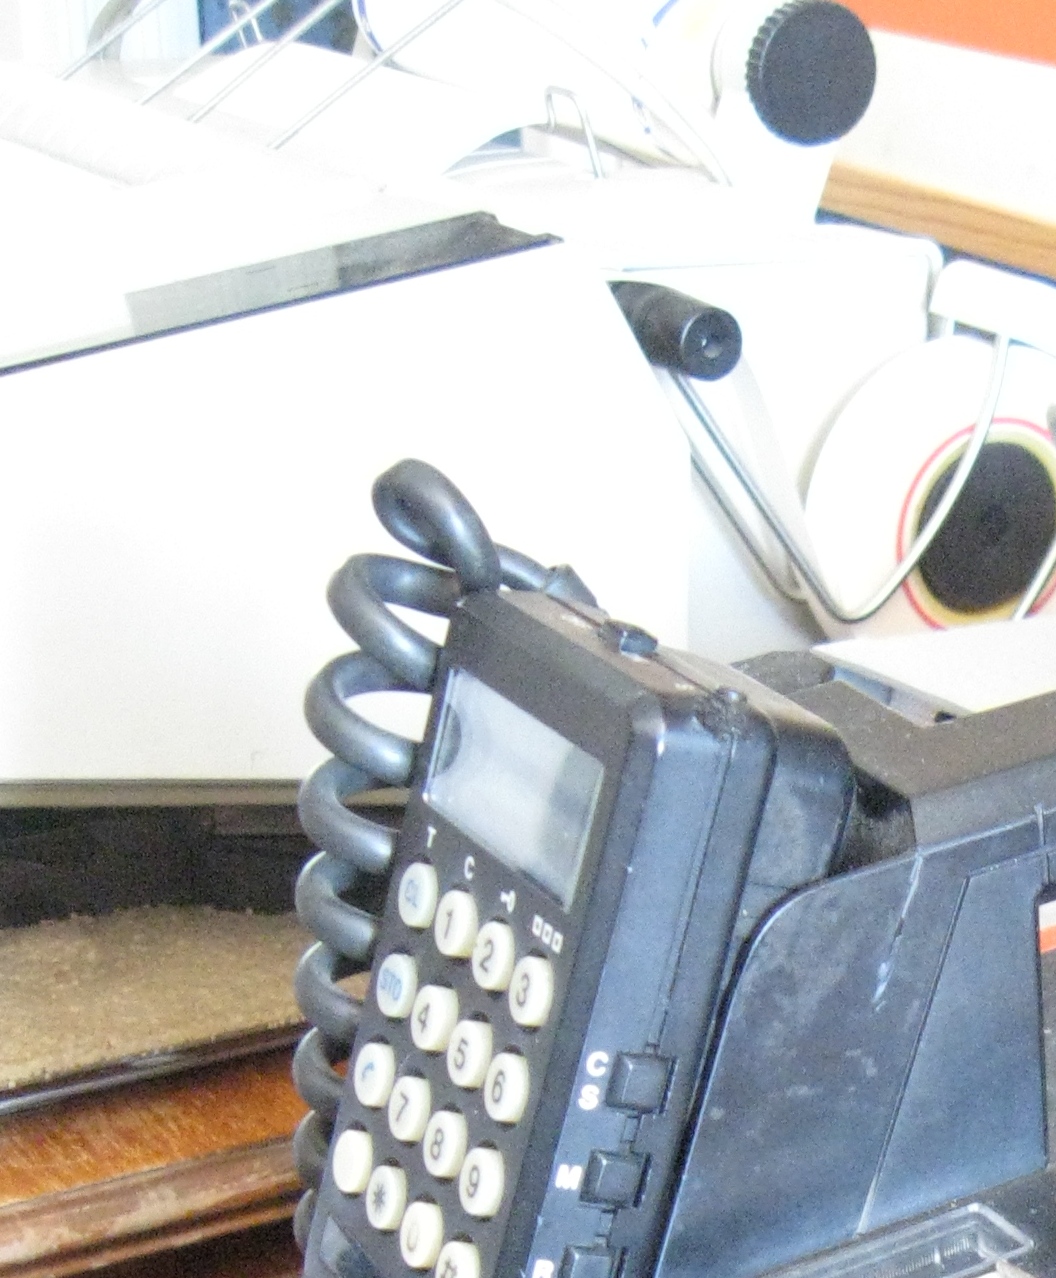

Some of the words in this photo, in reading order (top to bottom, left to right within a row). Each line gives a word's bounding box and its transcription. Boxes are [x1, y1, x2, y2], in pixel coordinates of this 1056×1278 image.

[443, 909, 455, 939] 1
[477, 939, 494, 972] 2
[514, 971, 530, 1003] 3
[378, 970, 404, 1003] STO
[416, 999, 431, 1031] 4
[453, 1036, 469, 1067] 5
[489, 1070, 505, 1104] 6
[399, 1093, 412, 1123] 7
[429, 1127, 445, 1161] 8
[465, 1163, 481, 1198] 9
